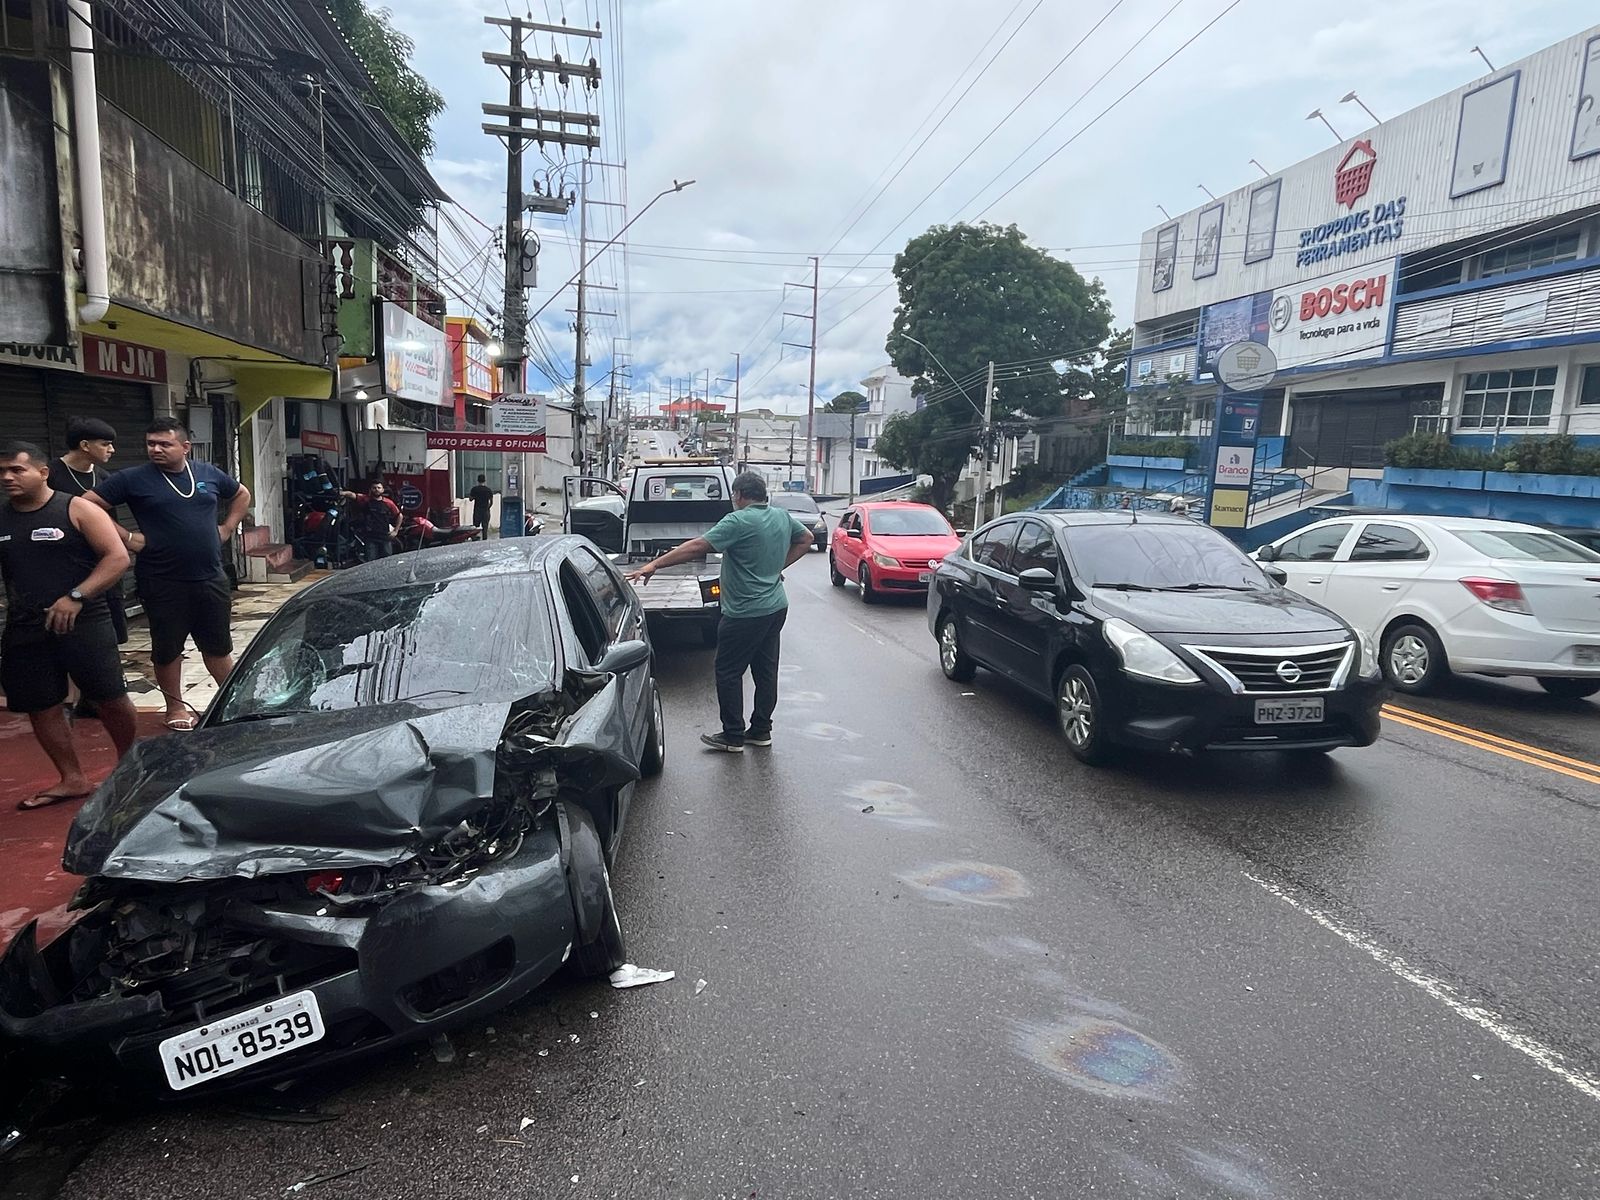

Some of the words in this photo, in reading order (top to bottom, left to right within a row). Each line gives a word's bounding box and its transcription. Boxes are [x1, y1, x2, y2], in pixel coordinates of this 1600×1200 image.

[1298, 210, 1370, 248] SHOPPING
[1373, 196, 1406, 224] DAS
[1296, 219, 1404, 268] FERRAMENTAS
[1300, 274, 1387, 321] BOSCH
[1300, 326, 1335, 340] Tecnologia
[1337, 323, 1354, 336] para
[1356, 322, 1361, 331] a
[1363, 317, 1380, 329] vida
[98, 341, 156, 378] MJM
[428, 438, 457, 446] MOTO
[460, 438, 493, 447] PEÇAS
[496, 439, 502, 447] E
[505, 440, 545, 448] OFICINA
[1218, 464, 1249, 475] Branco
[1213, 505, 1244, 513] Stamaco
[1258, 706, 1322, 721] PHZ-3720
[174, 1011, 314, 1081] NOL-8539
